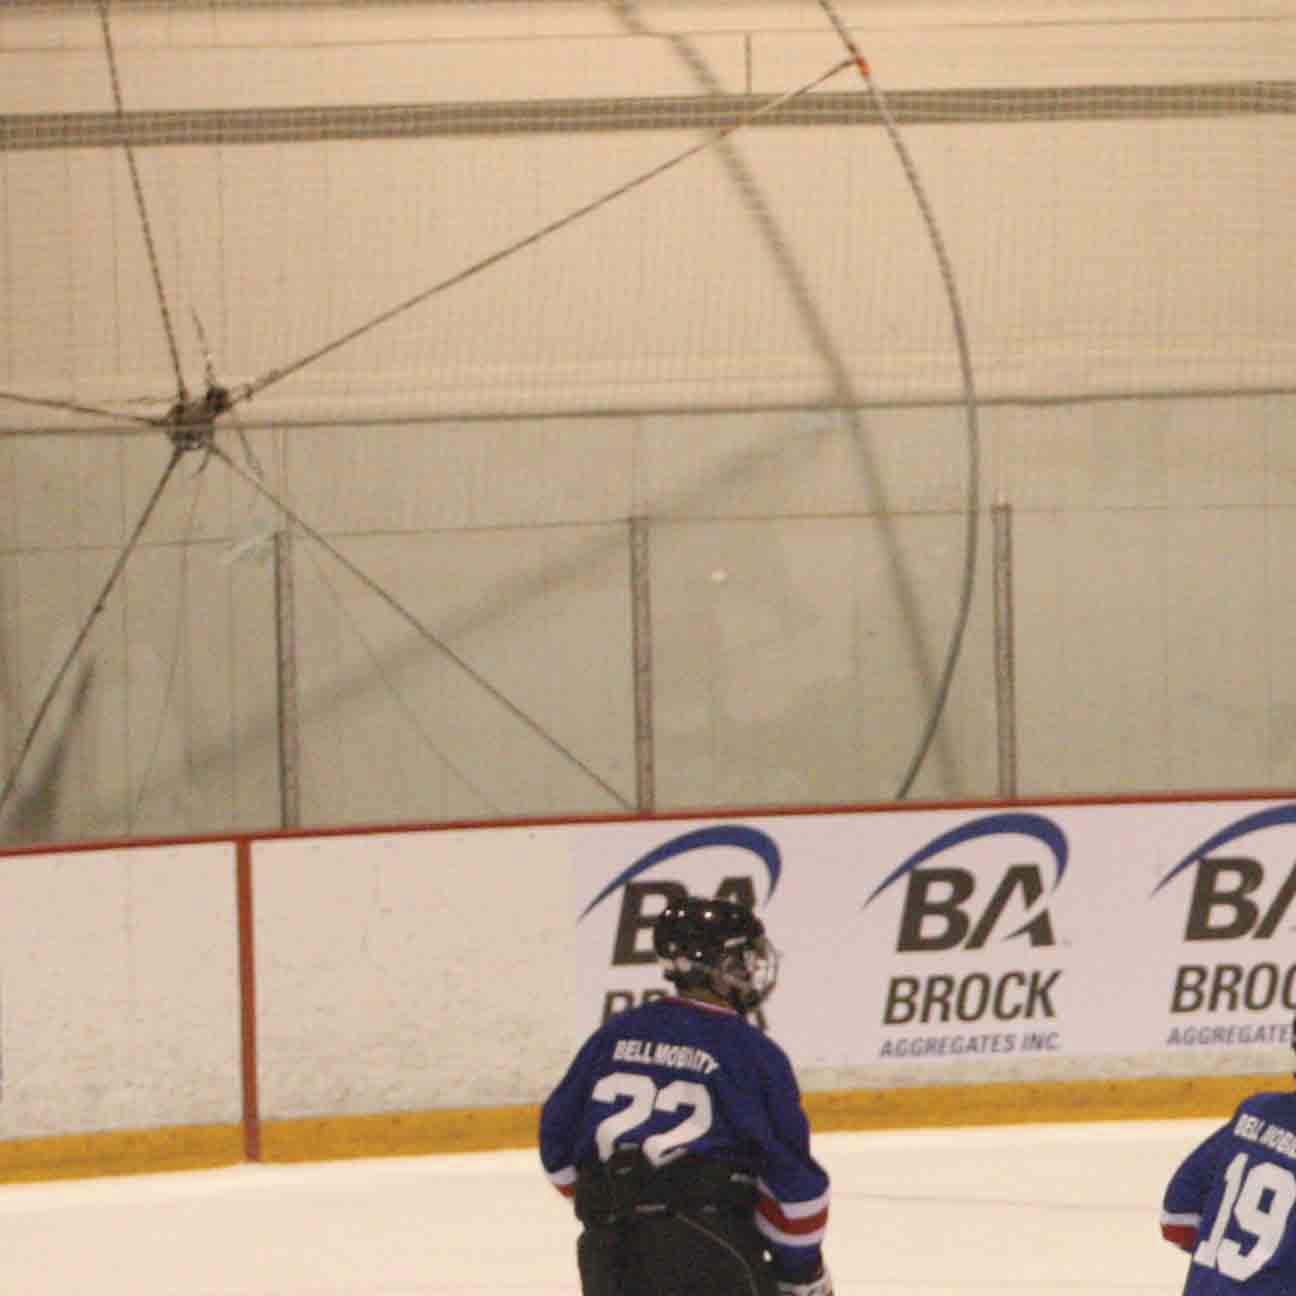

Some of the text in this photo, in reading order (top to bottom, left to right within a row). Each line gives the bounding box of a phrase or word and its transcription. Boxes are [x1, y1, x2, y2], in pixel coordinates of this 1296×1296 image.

[896, 863, 1056, 953] BA
[882, 970, 1062, 1025] BROCK
[879, 1034, 1016, 1057] AGGREGATES
[1166, 1025, 1296, 1046] AGGREGATE
[591, 1072, 713, 1167] 22
